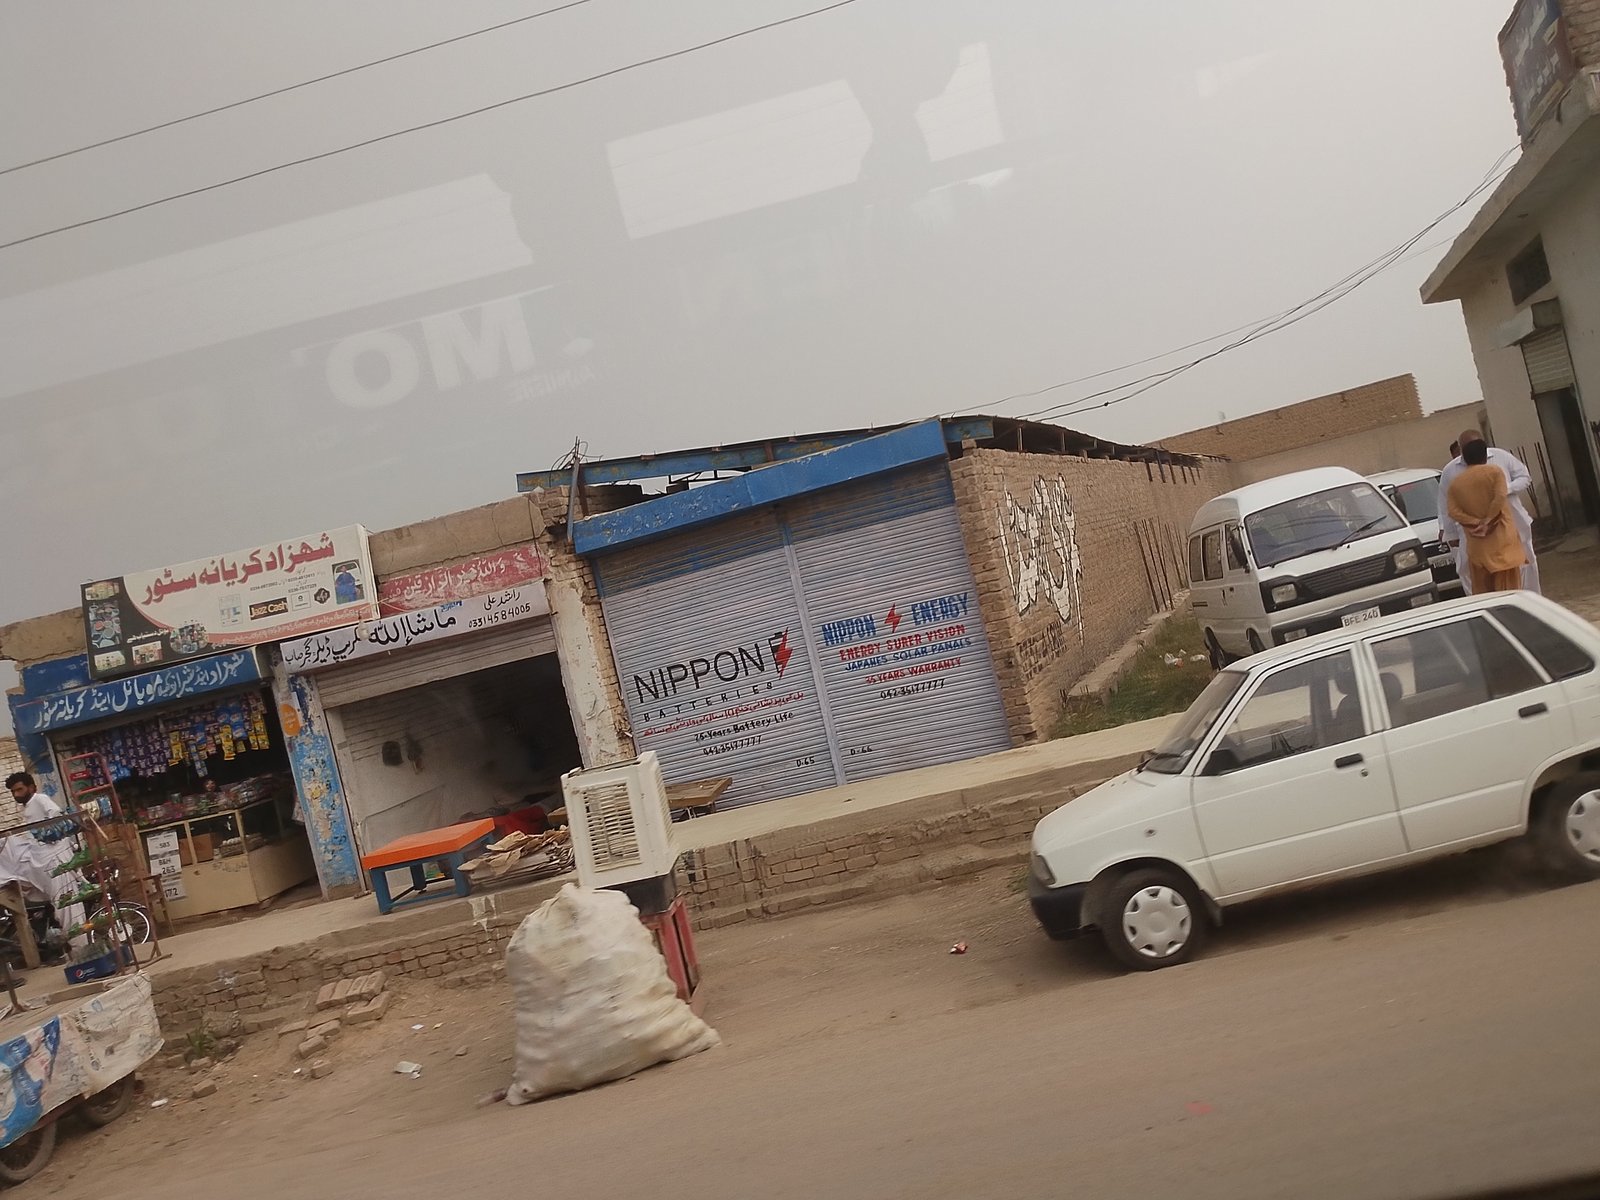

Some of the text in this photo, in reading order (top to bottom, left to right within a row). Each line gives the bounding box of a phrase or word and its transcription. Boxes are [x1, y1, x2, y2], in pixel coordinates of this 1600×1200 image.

[250, 605, 267, 617] Jazz
[268, 601, 288, 613] Cash
[469, 603, 531, 628] 03314584005
[821, 592, 968, 647] NIPPON ENERGY
[1344, 609, 1378, 627] BFE 240
[839, 642, 881, 661] ENERGY
[926, 624, 966, 642] VISION
[893, 646, 931, 662] SOLAR
[633, 643, 765, 703] NIPPON
[878, 671, 905, 683] YEARS
[909, 657, 962, 676] WARRANTY
[732, 718, 771, 735] Battery
